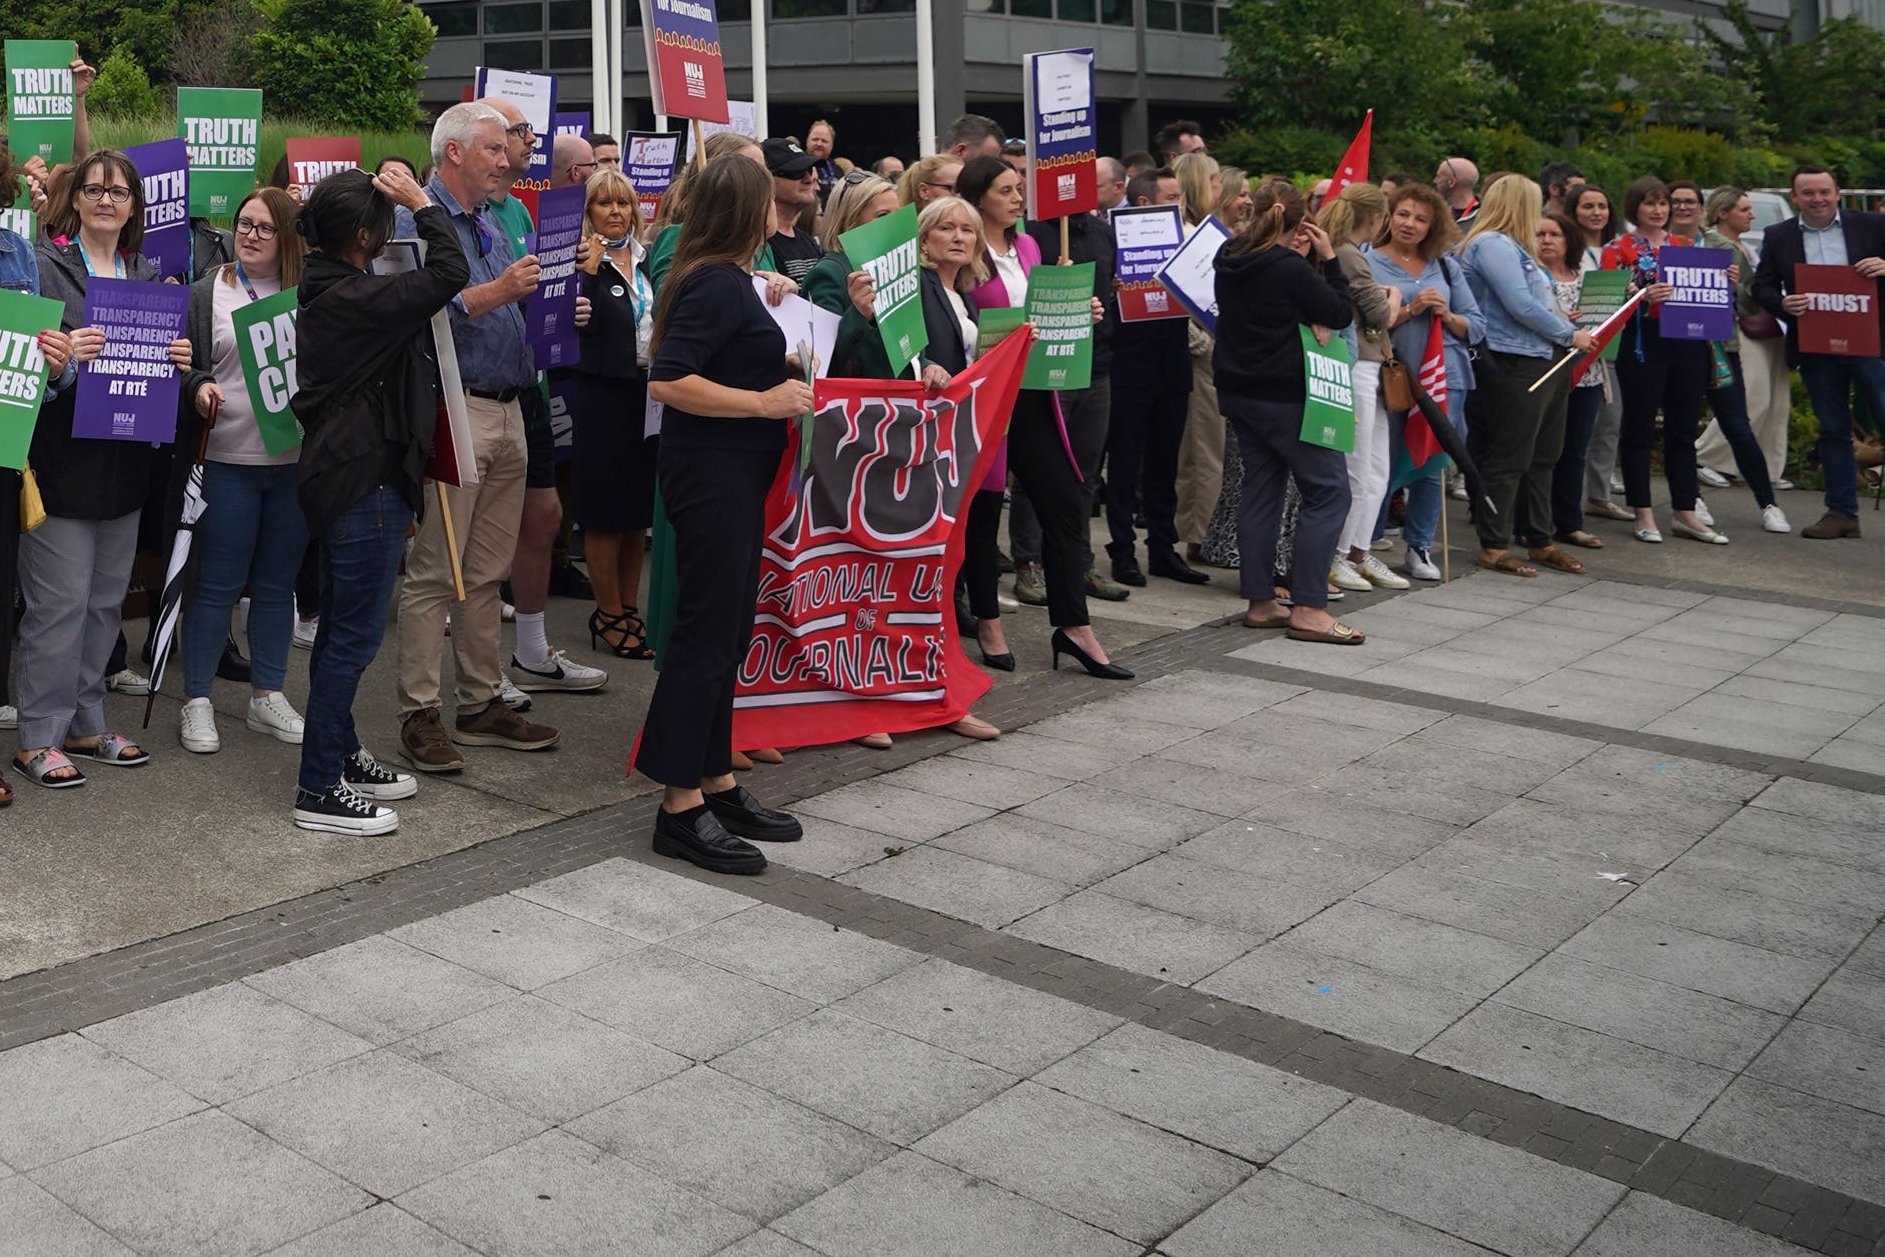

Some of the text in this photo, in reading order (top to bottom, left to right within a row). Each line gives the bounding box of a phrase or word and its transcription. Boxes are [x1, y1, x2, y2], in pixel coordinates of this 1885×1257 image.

[683, 61, 704, 79] NUJ
[12, 68, 72, 94] TRUTH
[14, 96, 72, 115] MATTERS
[1043, 109, 1087, 126] Standing up
[184, 117, 257, 145] TRUTH
[1039, 125, 1091, 144] for Journalism
[39, 144, 52, 152] NUJ
[186, 146, 256, 166] MATTERS
[140, 169, 185, 205] UTH
[1057, 173, 1076, 187] NUJ
[210, 195, 227, 204] NUJ
[861, 238, 917, 291] TRUTH
[1123, 249, 1163, 262] Standing
[1120, 263, 1138, 275] for
[1664, 266, 1728, 288] TRUTH
[873, 270, 918, 317] MATTERS
[1033, 287, 1091, 300] TRANSPARENCY
[1144, 292, 1167, 303] NUJ
[1805, 292, 1871, 313] TRUST
[1031, 299, 1091, 314] TRANSPARENCY
[92, 307, 181, 328] TRANSPARENCY
[1029, 312, 1091, 327] TRANSPARENCY
[248, 308, 297, 369] PA
[1039, 326, 1091, 340] ANSPARENCY
[99, 342, 170, 361] ANSPARENC
[1046, 343, 1075, 356] AT RTÉ
[88, 359, 175, 378] TRANSPARENCY
[1307, 351, 1350, 386] TRUTH
[109, 380, 148, 396] AT RTÉ
[1309, 377, 1352, 406] MATTERS
[113, 413, 135, 423] NUJ
[550, 395, 573, 448] PAY
[854, 609, 877, 631] OF
